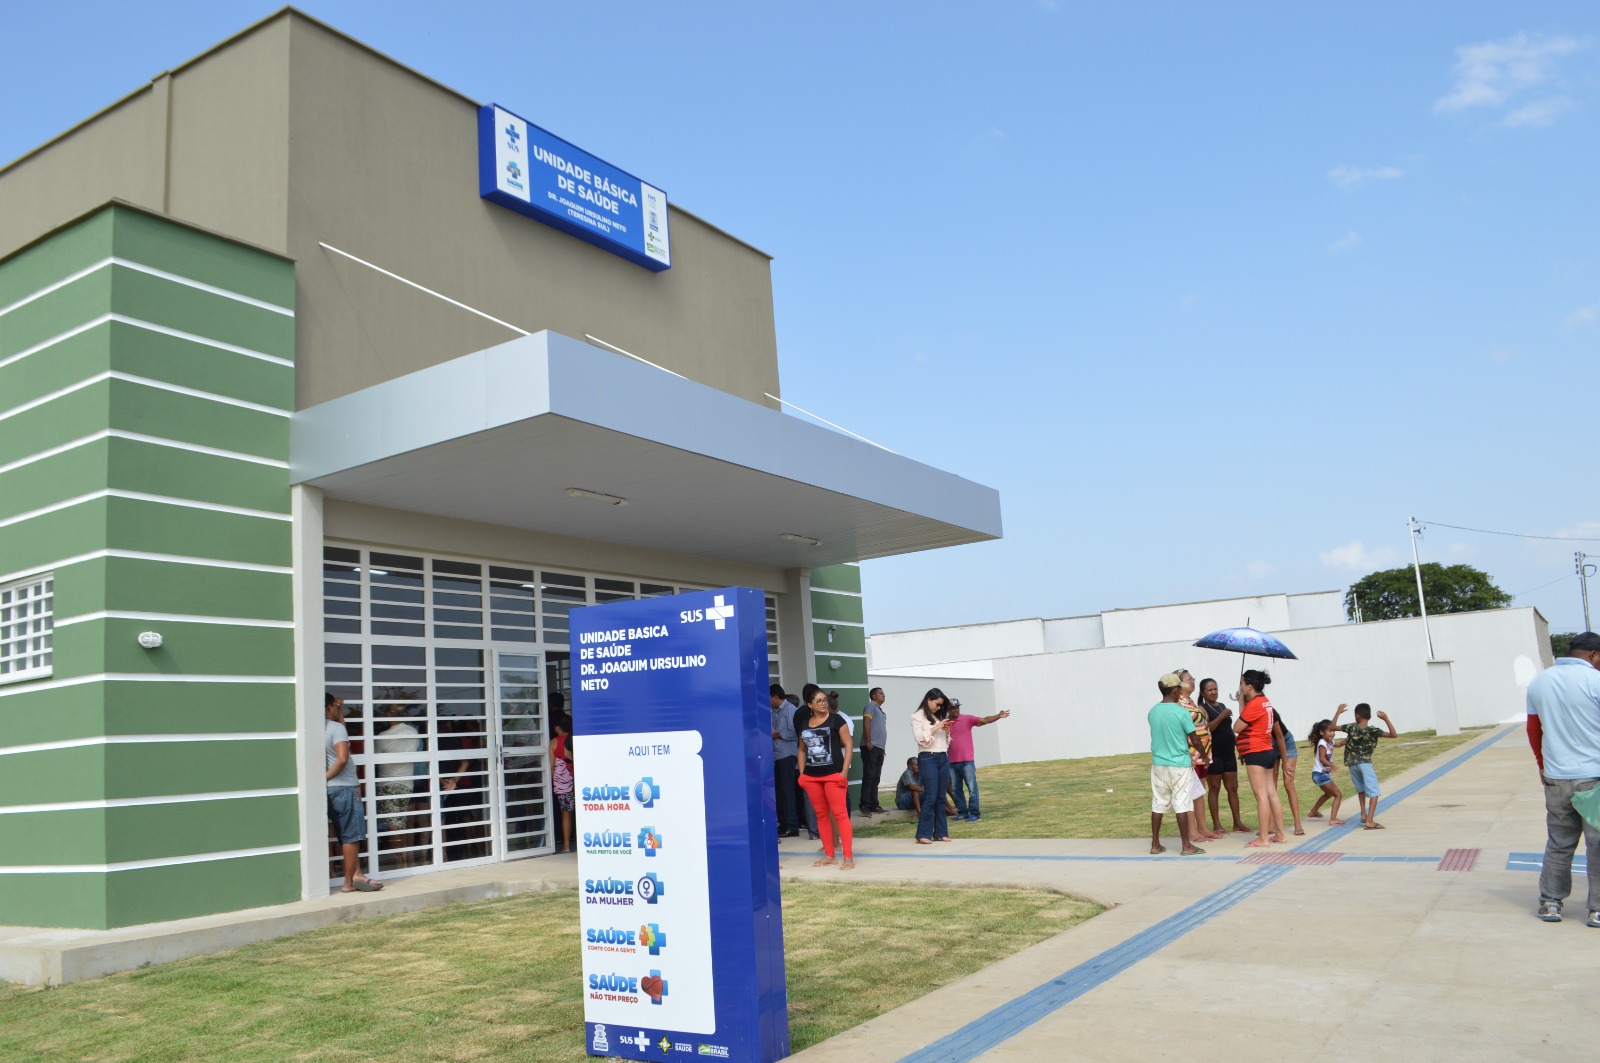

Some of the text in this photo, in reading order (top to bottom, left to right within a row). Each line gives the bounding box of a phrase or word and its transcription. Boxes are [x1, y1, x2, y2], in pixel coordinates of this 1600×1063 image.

[507, 142, 519, 152] SUS
[534, 144, 638, 208] UNIDADE BÁSICA
[558, 174, 619, 214] DE SAÚDE
[548, 191, 626, 232] DR. JOAQUIM URSULINO NETO
[568, 208, 610, 233] (TERESINA SUL)
[680, 610, 704, 624] SUS
[580, 625, 668, 644] UNIDADE BASICA
[580, 642, 632, 660] DE SAÚDE
[580, 654, 706, 675] DR. JOAQUIM URSULINO
[581, 678, 609, 691] NETO
[628, 745, 670, 756] AQUI TEM
[582, 784, 630, 802] SAÚDE
[607, 803, 630, 811] HORA
[584, 829, 632, 848] SAÚDE
[585, 877, 634, 895] SAÚDE
[586, 897, 634, 906] DA MULHER
[586, 927, 636, 946] SAÚDE
[589, 972, 638, 994] SAÚDE
[590, 992, 638, 1004] NÃO TEM PREÇO
[620, 1036, 633, 1044] SUS
